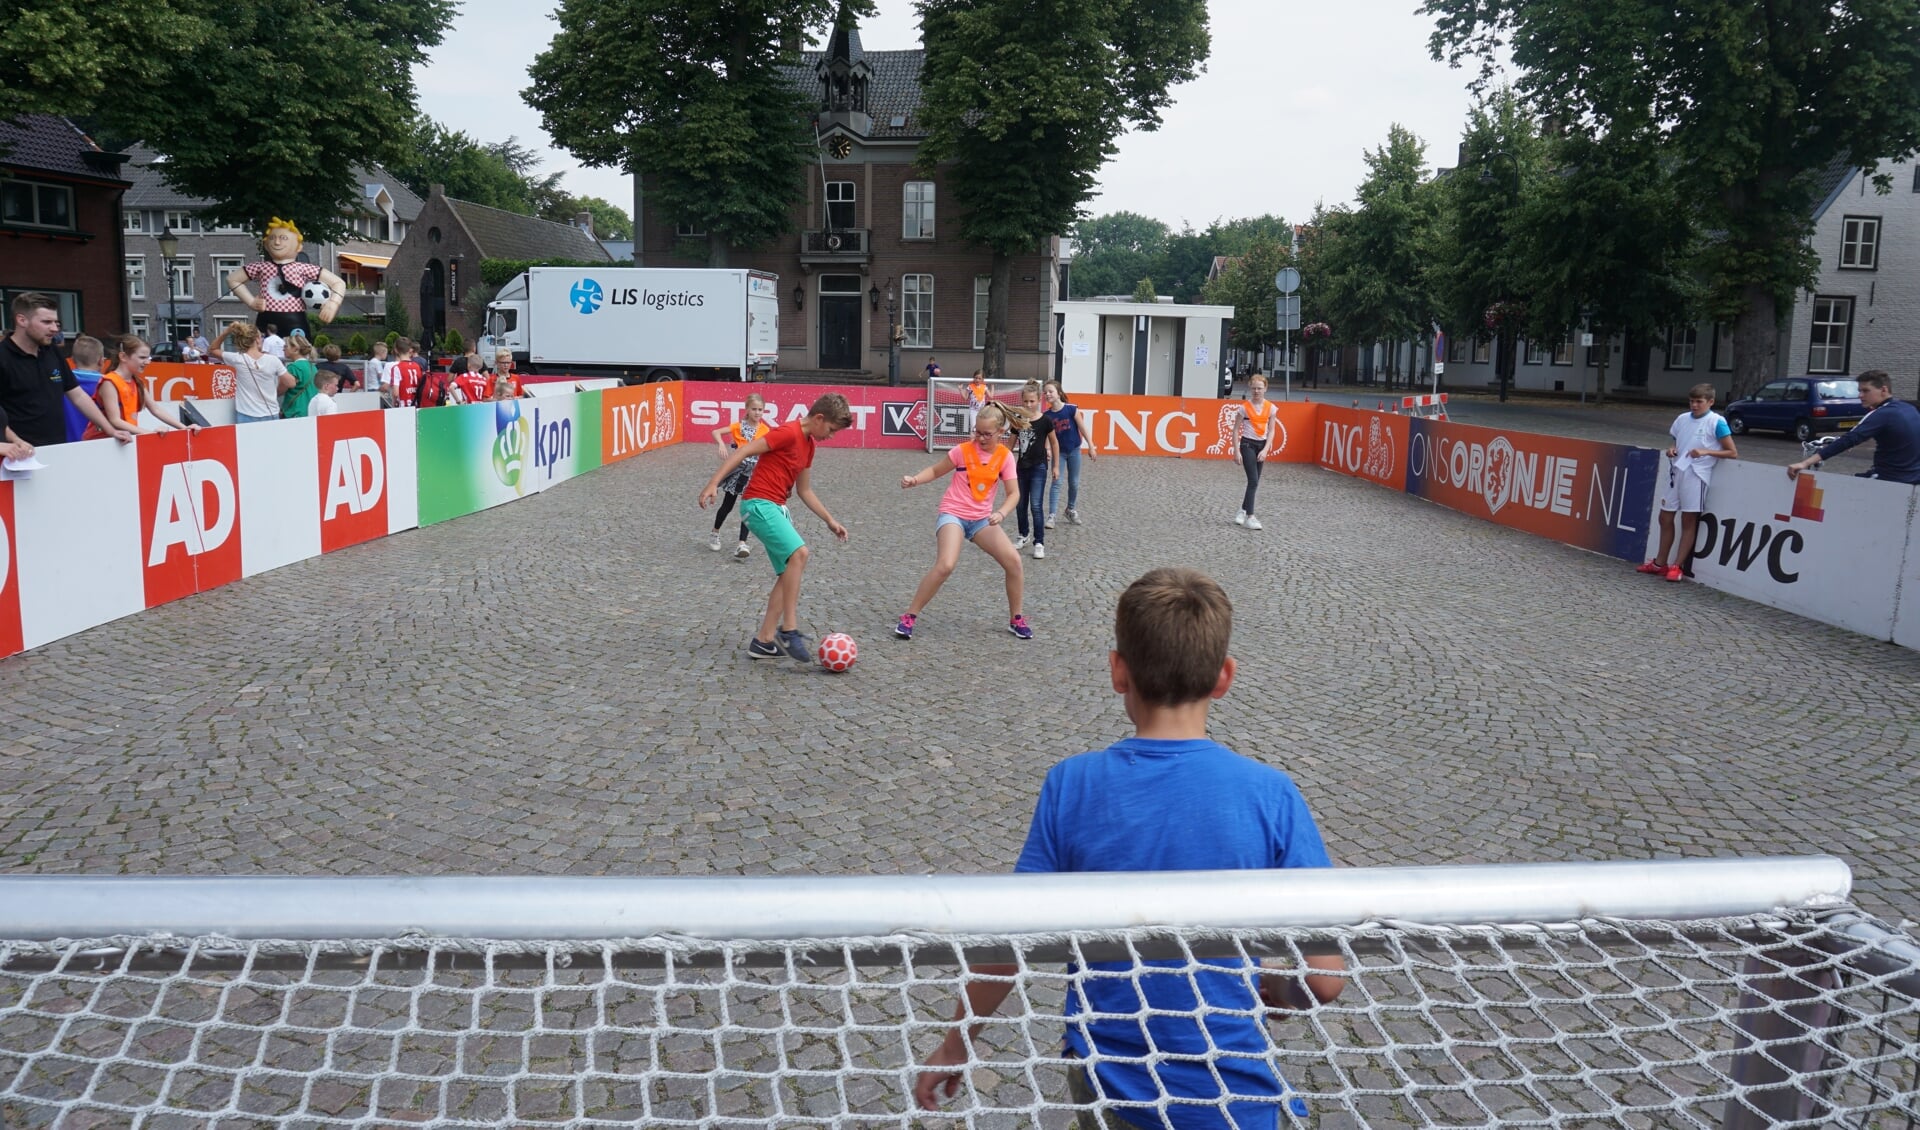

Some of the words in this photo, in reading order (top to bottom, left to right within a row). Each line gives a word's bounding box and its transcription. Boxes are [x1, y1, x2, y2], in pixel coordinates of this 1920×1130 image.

[611, 288, 638, 305] LIS
[642, 288, 705, 311] logistics
[534, 407, 571, 479] kpn
[611, 402, 651, 457] ING
[690, 400, 876, 431] STRAT
[1078, 409, 1200, 454] ING
[1321, 419, 1363, 474] ING
[324, 436, 385, 523] AD
[148, 458, 236, 568] AD
[1683, 512, 1804, 584] pwc
